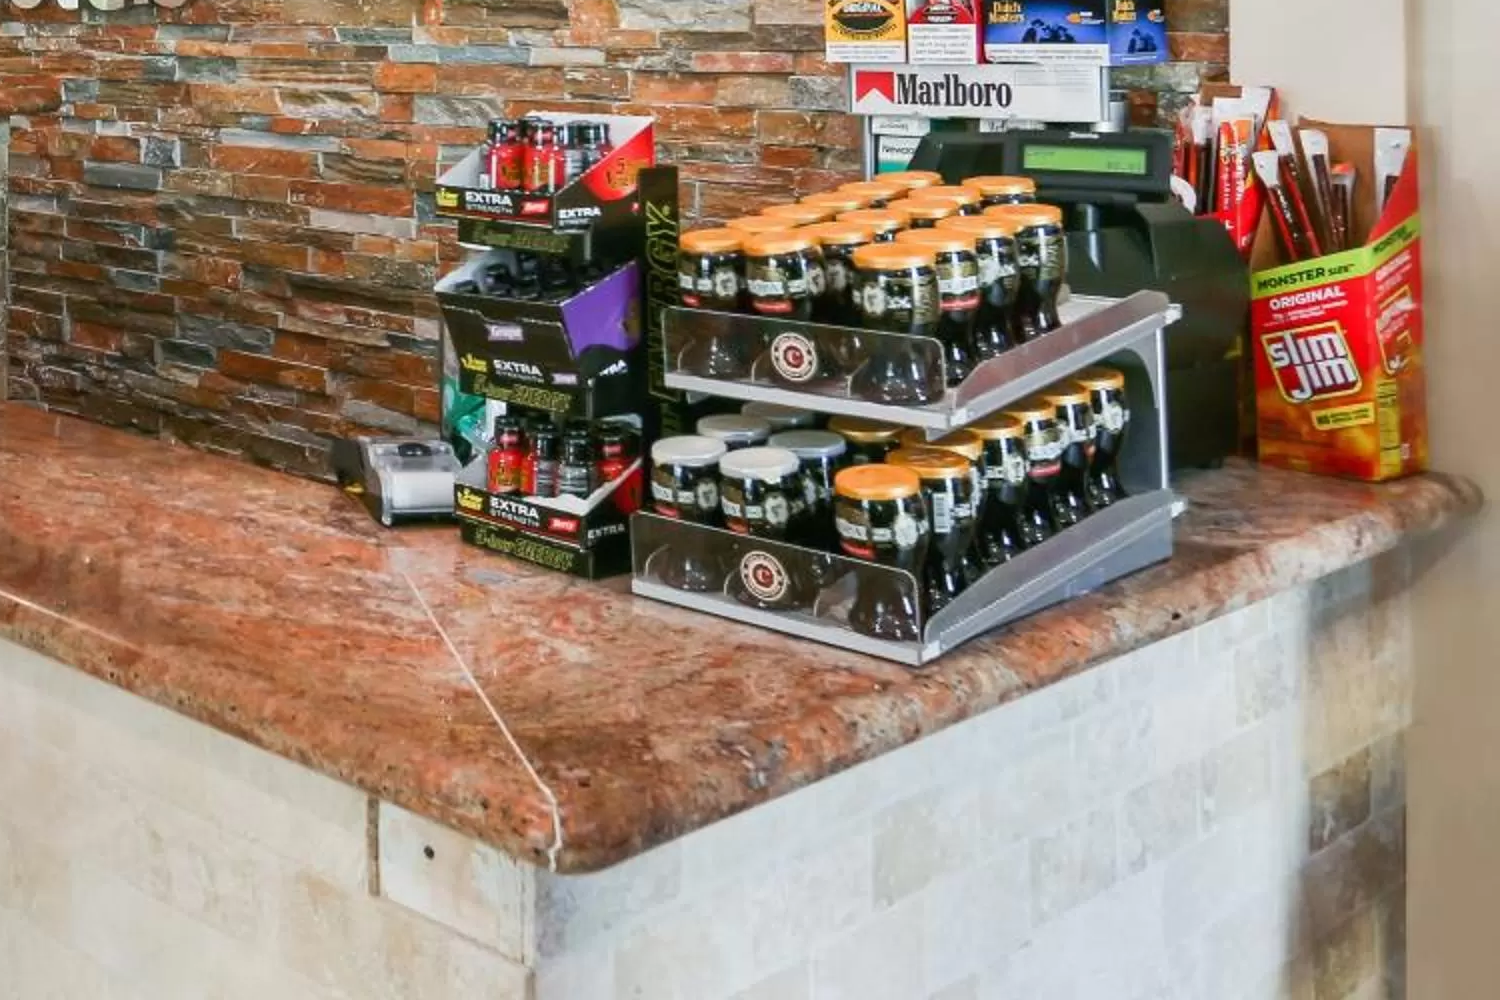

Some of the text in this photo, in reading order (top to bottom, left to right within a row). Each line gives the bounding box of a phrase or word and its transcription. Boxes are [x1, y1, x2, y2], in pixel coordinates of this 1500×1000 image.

[896, 73, 1012, 108] Marlboro
[465, 190, 514, 207] EXTRA
[558, 206, 602, 219] EXTRA
[1257, 267, 1325, 291] MONSTER
[1269, 285, 1346, 311] ORIGINAL
[493, 359, 543, 376] EXTRA
[489, 495, 539, 519] EXTRA
[587, 522, 626, 540] EXTRA
